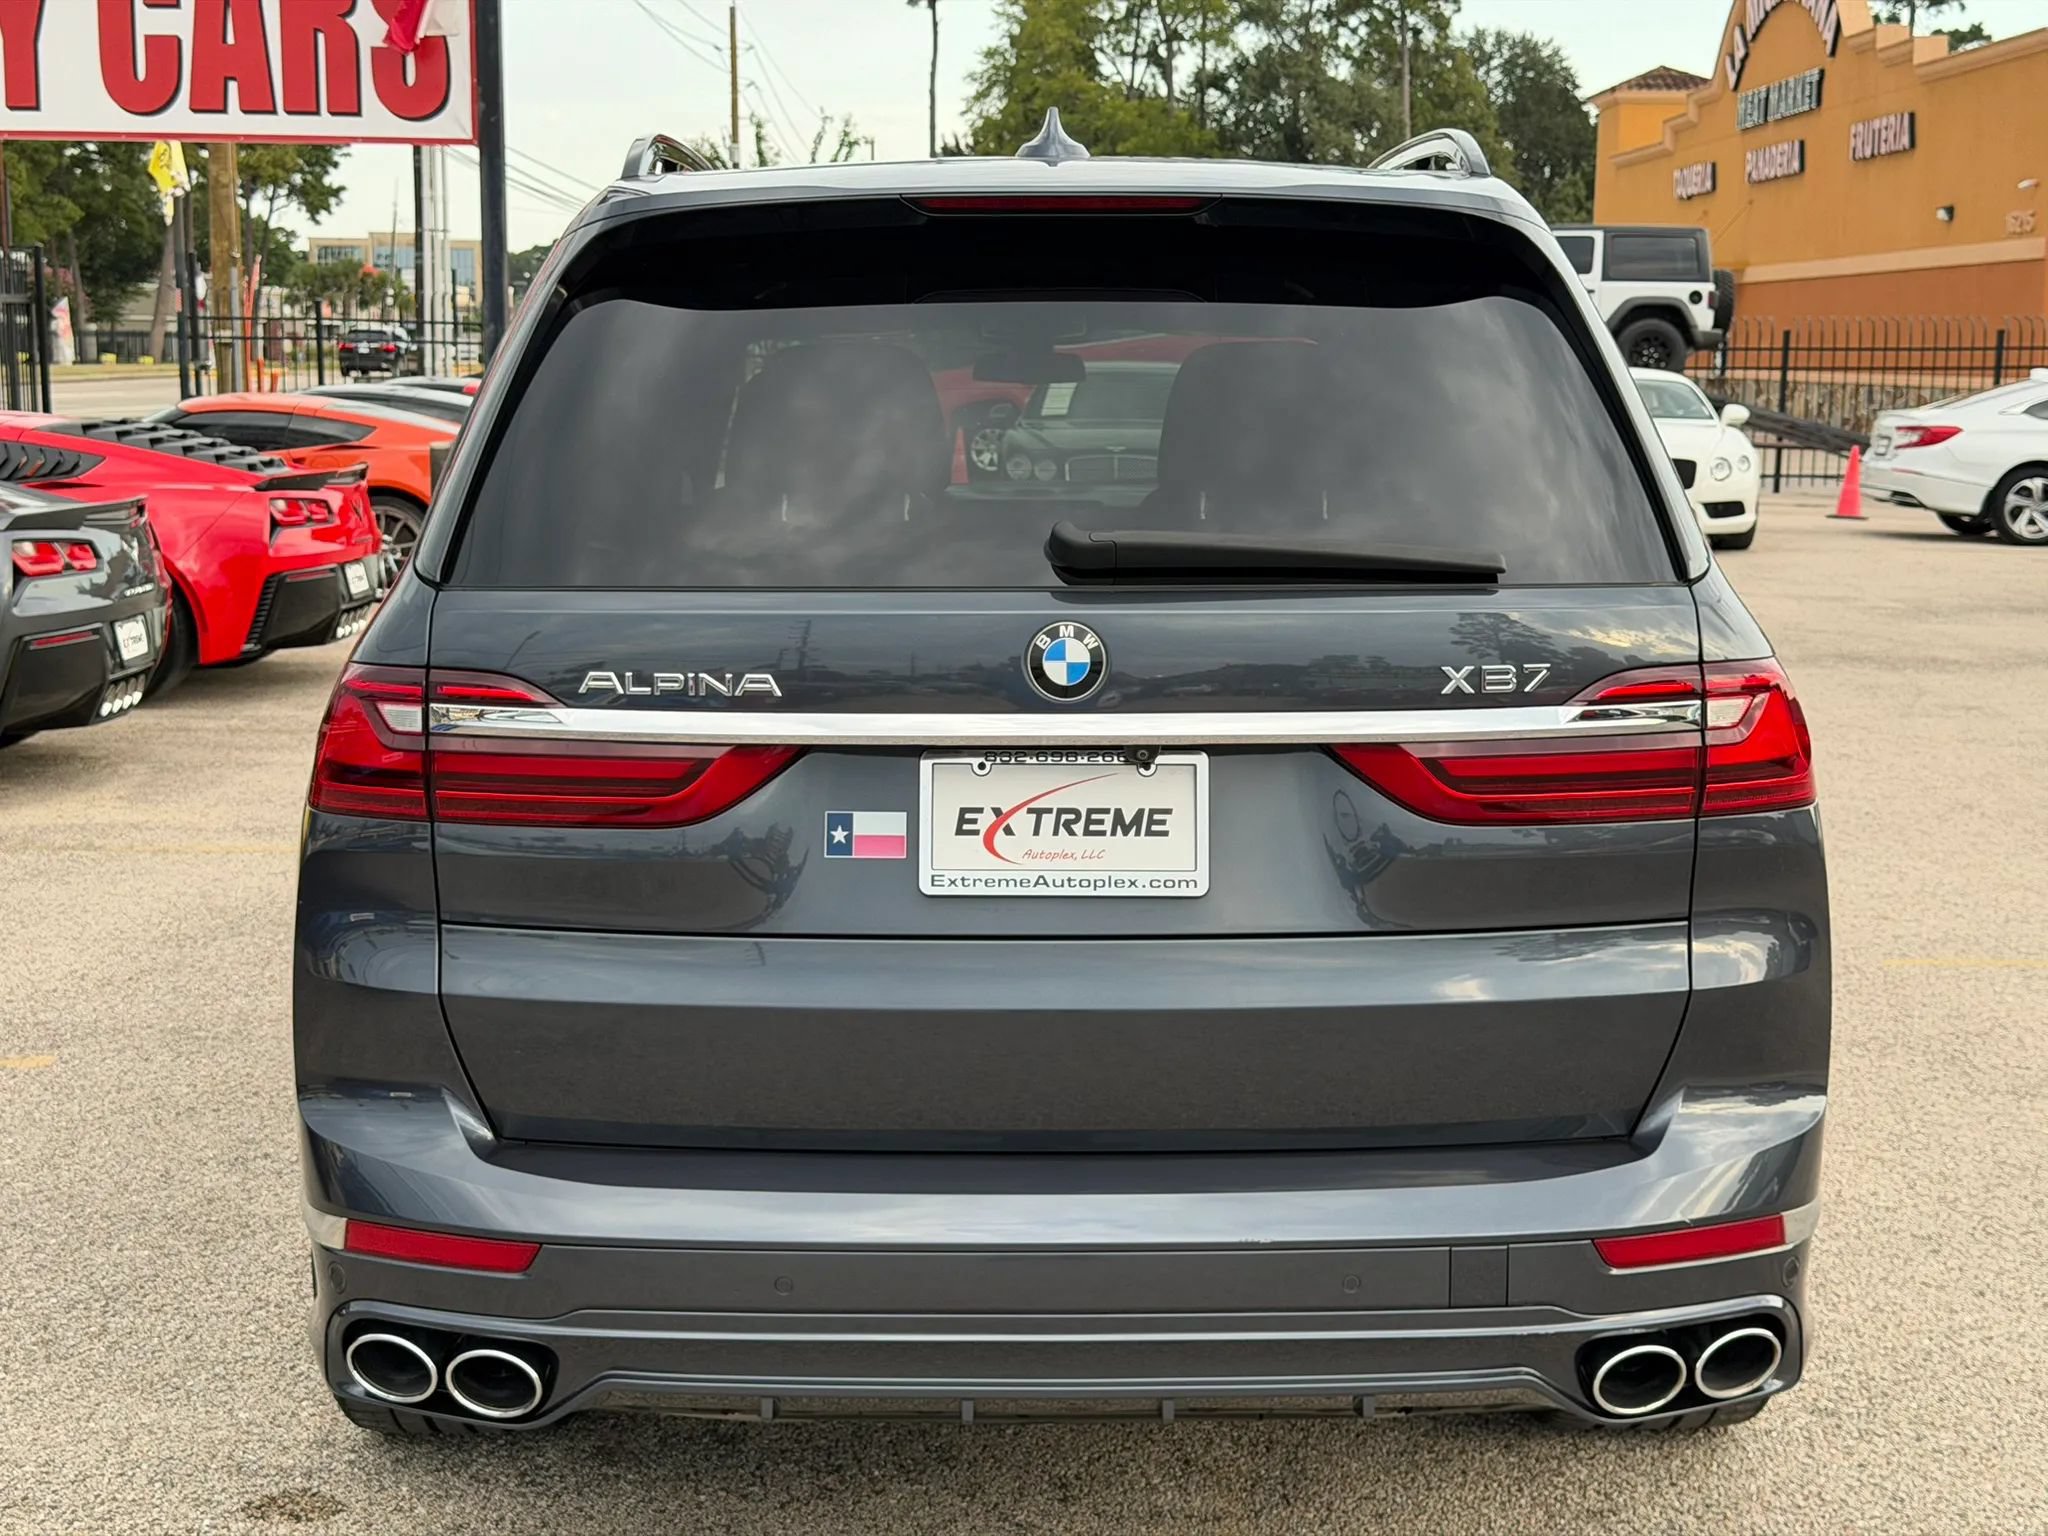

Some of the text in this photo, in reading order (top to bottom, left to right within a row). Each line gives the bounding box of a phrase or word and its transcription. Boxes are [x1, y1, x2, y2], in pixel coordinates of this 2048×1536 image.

[98, 0, 450, 121] CARS
[1737, 67, 1824, 130] MEAT MARKET
[1850, 112, 1915, 161] FRUTERIA
[1745, 139, 1805, 184] PANADERIA
[1673, 161, 1716, 200] TAQUERIA
[1035, 625, 1099, 650] BMW
[1440, 663, 1551, 694] XB7
[954, 807, 1174, 838] EXTREME
[1022, 849, 1106, 862] Autoplex, LLC
[930, 874, 1198, 891] ExtremeAutoplex.com
